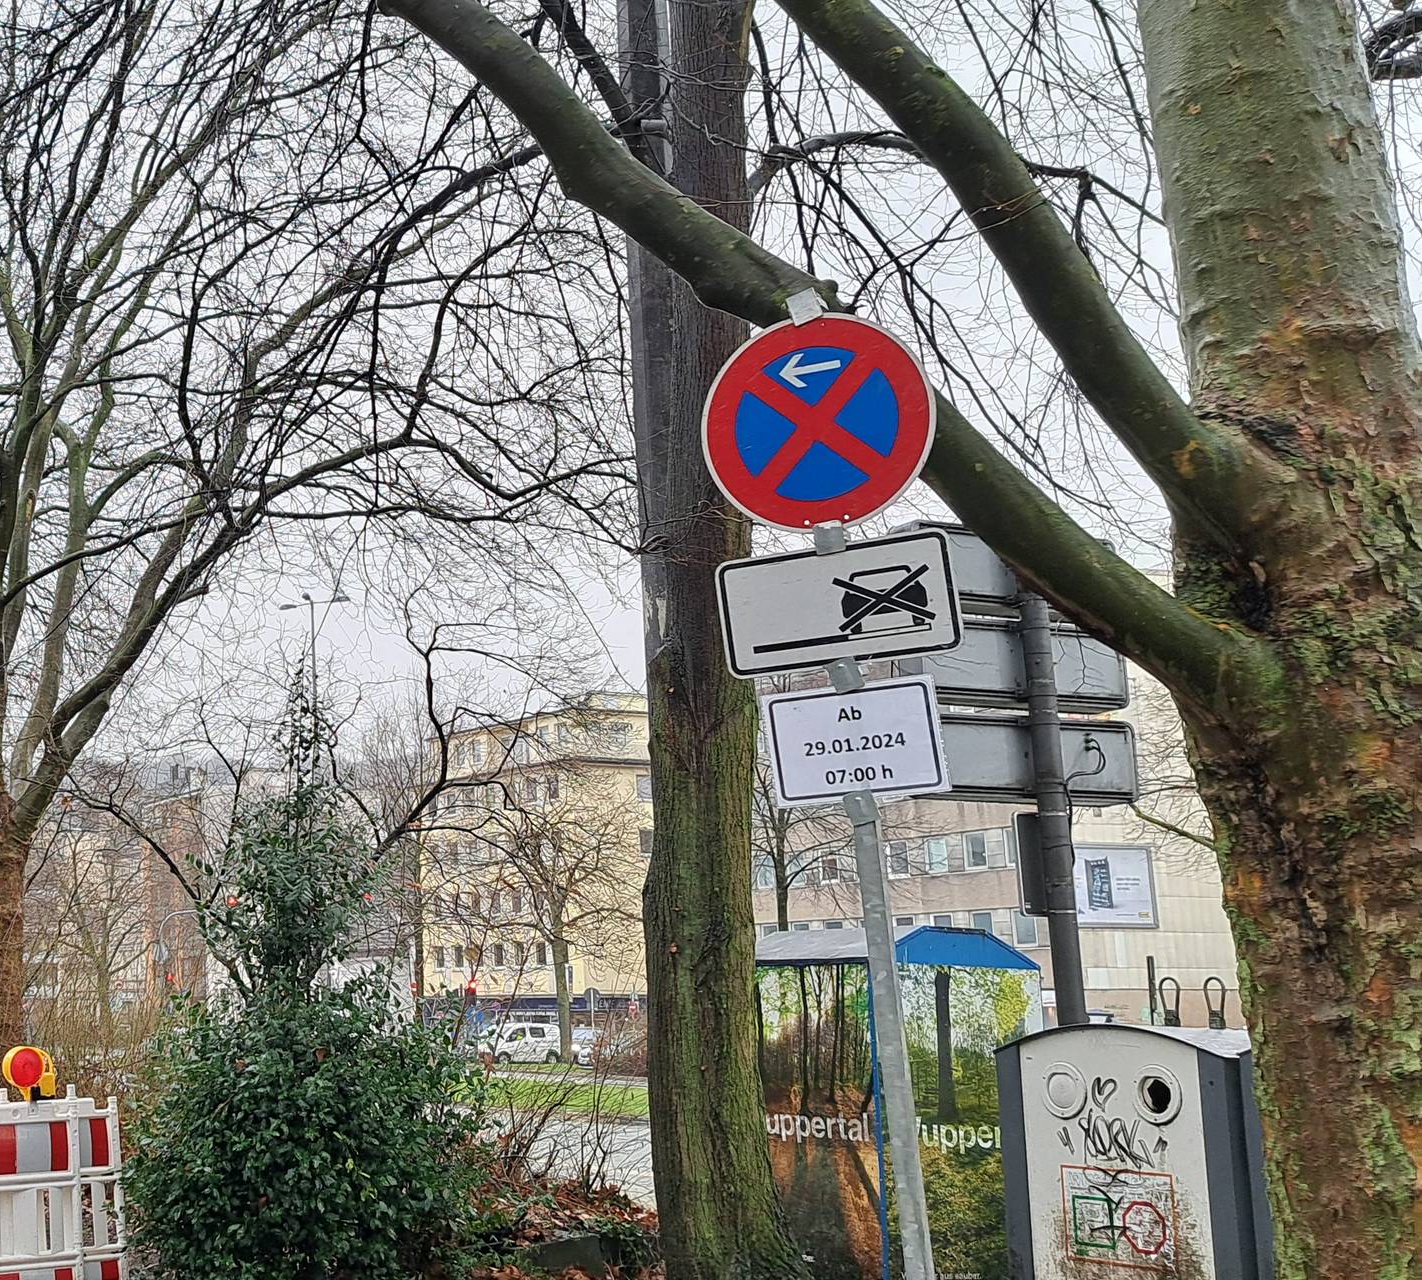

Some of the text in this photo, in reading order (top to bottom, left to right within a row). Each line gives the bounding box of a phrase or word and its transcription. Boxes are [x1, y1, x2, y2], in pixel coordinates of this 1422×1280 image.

[837, 706, 862, 722] Ab
[803, 732, 906, 757] 29.01.2024
[825, 765, 894, 785] 07:00 h
[765, 1112, 870, 1142] uppertal
